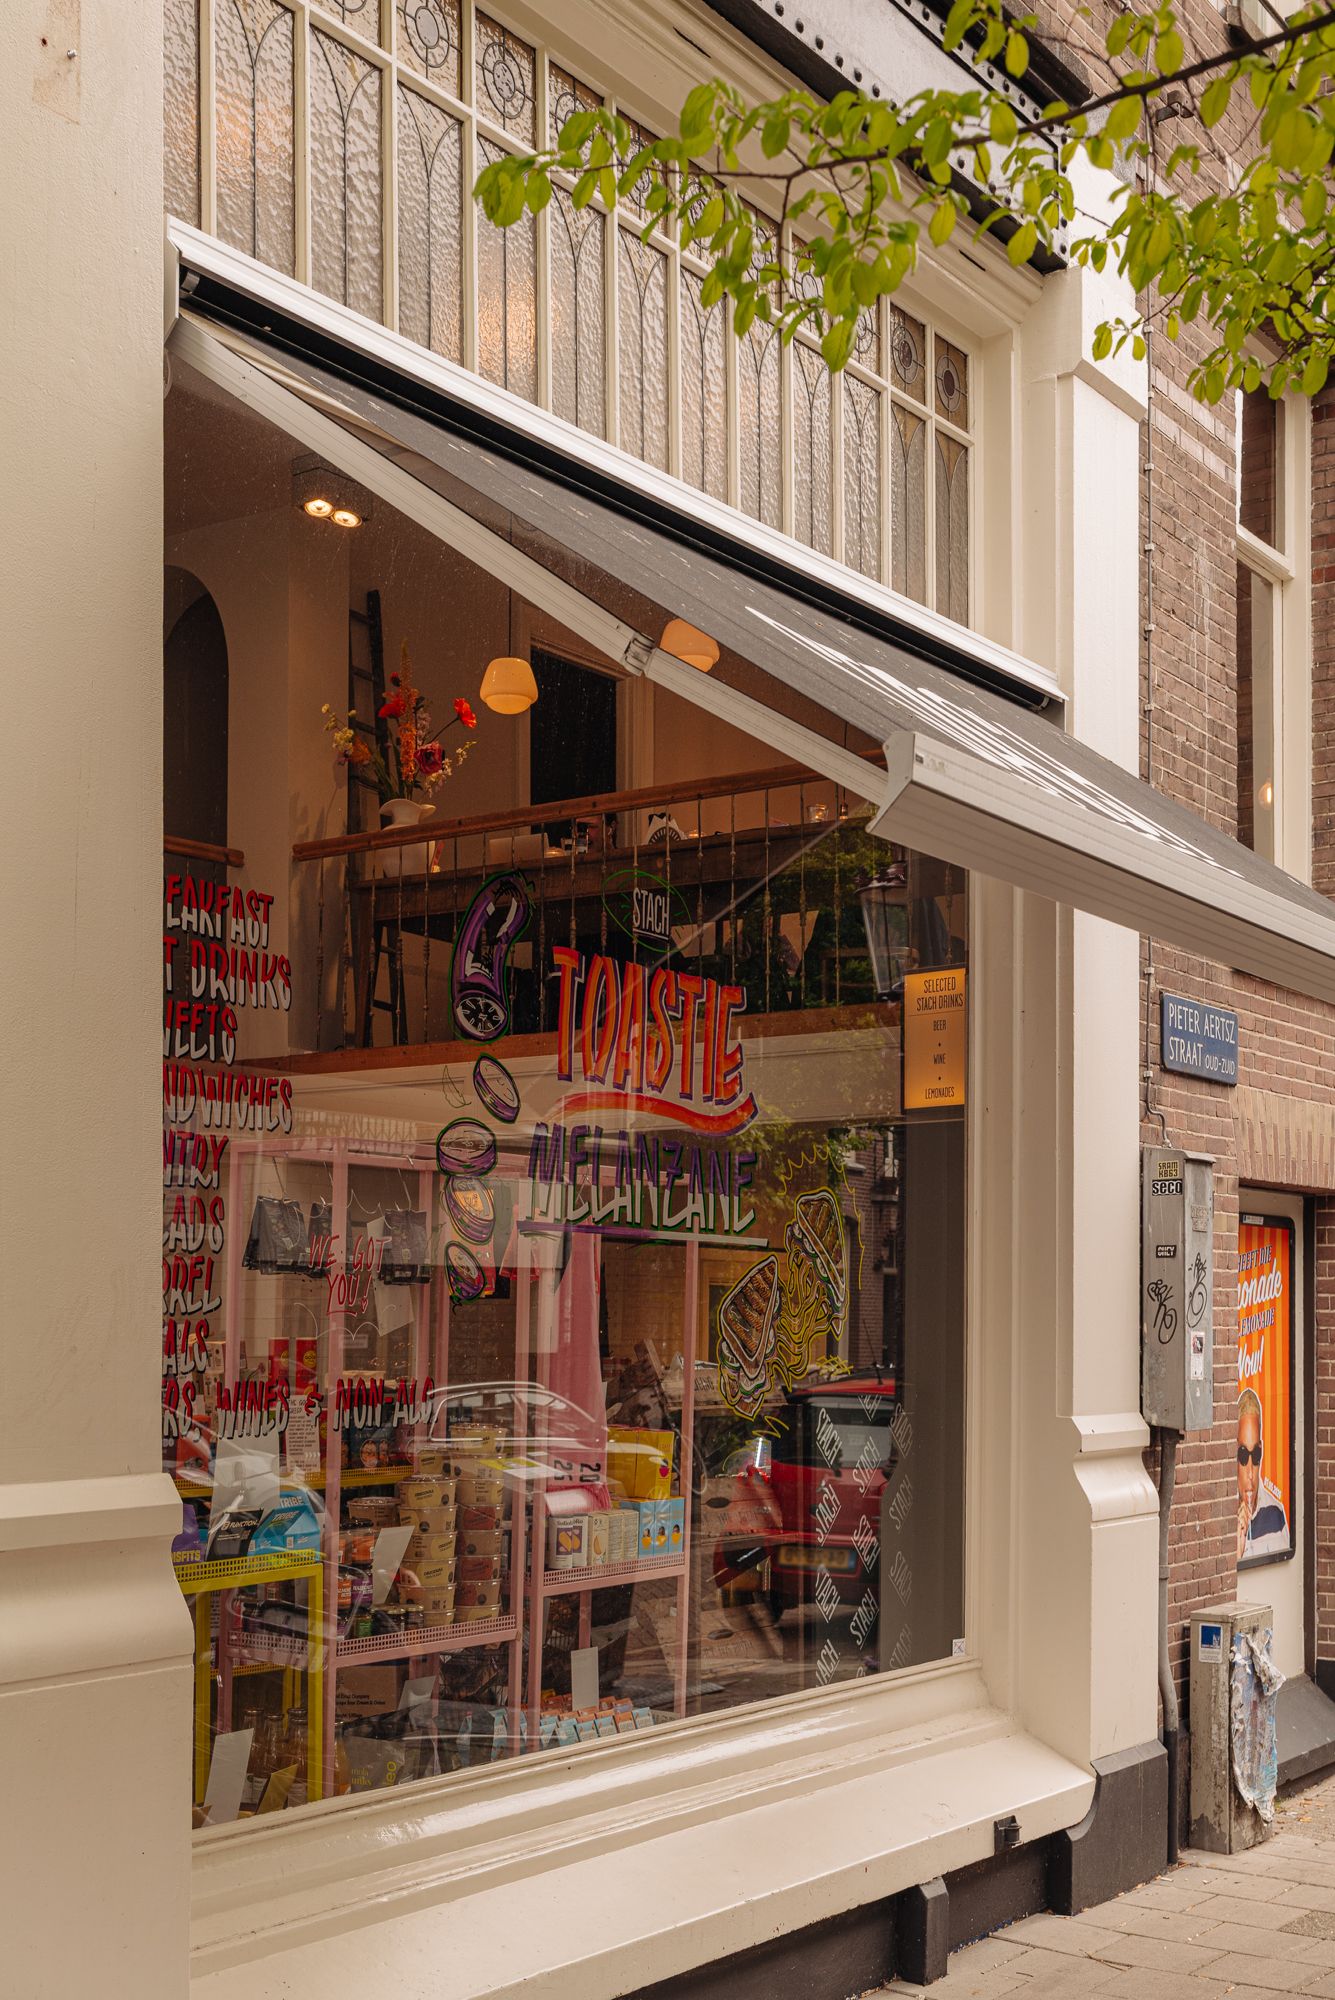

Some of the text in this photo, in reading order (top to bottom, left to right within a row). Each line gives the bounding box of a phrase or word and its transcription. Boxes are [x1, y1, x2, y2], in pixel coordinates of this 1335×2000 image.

[165, 874, 274, 949] EAKFAST
[632, 886, 670, 935] STACH
[191, 939, 292, 1011] DRINKS
[923, 976, 956, 994] SELECTED
[916, 992, 964, 1012] STACH DRINKS
[1168, 1002, 1236, 1044] PIETER AERTSZ
[552, 946, 748, 1106] TOASTIE
[933, 1019, 947, 1032] BEER
[933, 1053, 947, 1065] WINE
[1169, 1036, 1236, 1076] STRAAT OUD-ZUID
[925, 1086, 955, 1100] LEMONADES
[525, 1122, 758, 1233] MELANZANE
[1152, 1181, 1182, 1195] seco
[308, 1232, 393, 1273] WE GOT
[1259, 1245, 1273, 1266] DIE
[216, 1377, 290, 1440] WINES
[305, 1383, 324, 1427] &
[816, 1407, 843, 1467] STACH
[852, 1436, 881, 1497] STACH
[172, 1549, 201, 1563] ISFITS
[851, 1514, 880, 1573] STACH
[849, 1588, 880, 1649] STACH
